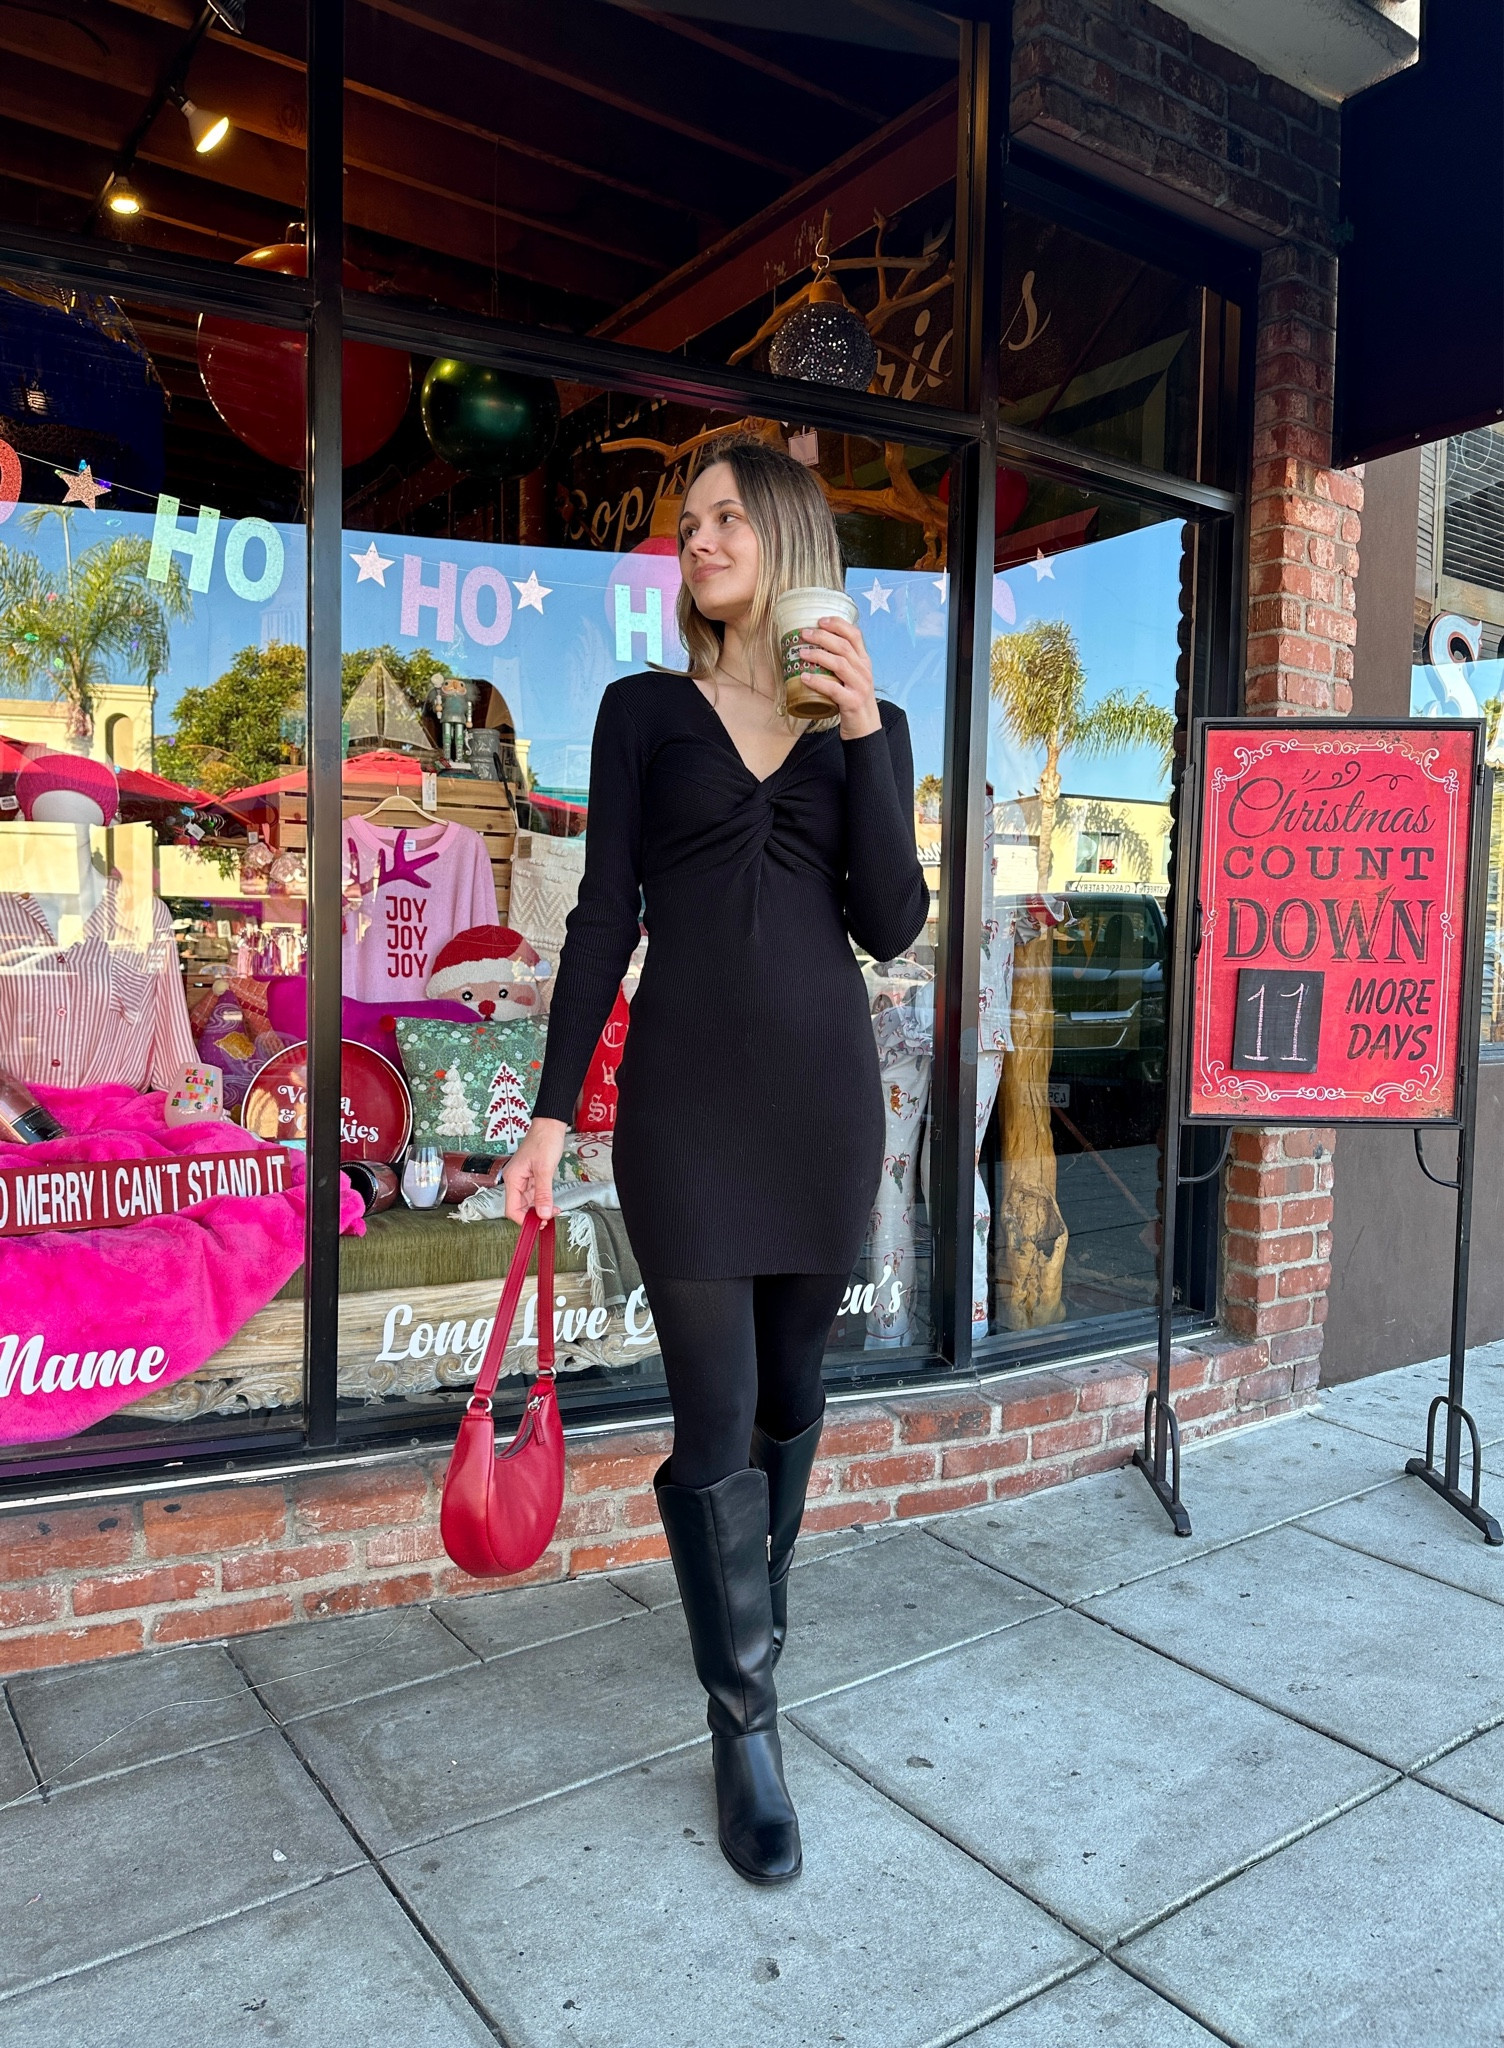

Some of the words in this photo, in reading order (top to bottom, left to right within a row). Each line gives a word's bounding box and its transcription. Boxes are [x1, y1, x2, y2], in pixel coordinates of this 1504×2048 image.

[145, 493, 285, 602] HO
[400, 553, 512, 646] HO
[614, 585, 663, 664] H
[1227, 776, 1435, 838] Christmas
[1223, 846, 1435, 881] COUNT
[385, 895, 427, 923] JOY
[387, 924, 428, 950] JOY
[1222, 884, 1437, 965] DOWN
[387, 952, 428, 978] JOY
[1242, 983, 1308, 1062] 11
[1344, 978, 1435, 1016] MORE
[1346, 1023, 1433, 1062] DAYS
[15, 1170, 95, 1227] MERRY
[101, 1170, 110, 1219] I
[115, 1163, 181, 1217] CAN'T
[187, 1157, 261, 1204] STAND
[266, 1155, 285, 1193] IT
[375, 1304, 496, 1375] Long
[515, 1293, 612, 1347] Live
[0, 1334, 170, 1398] Name
